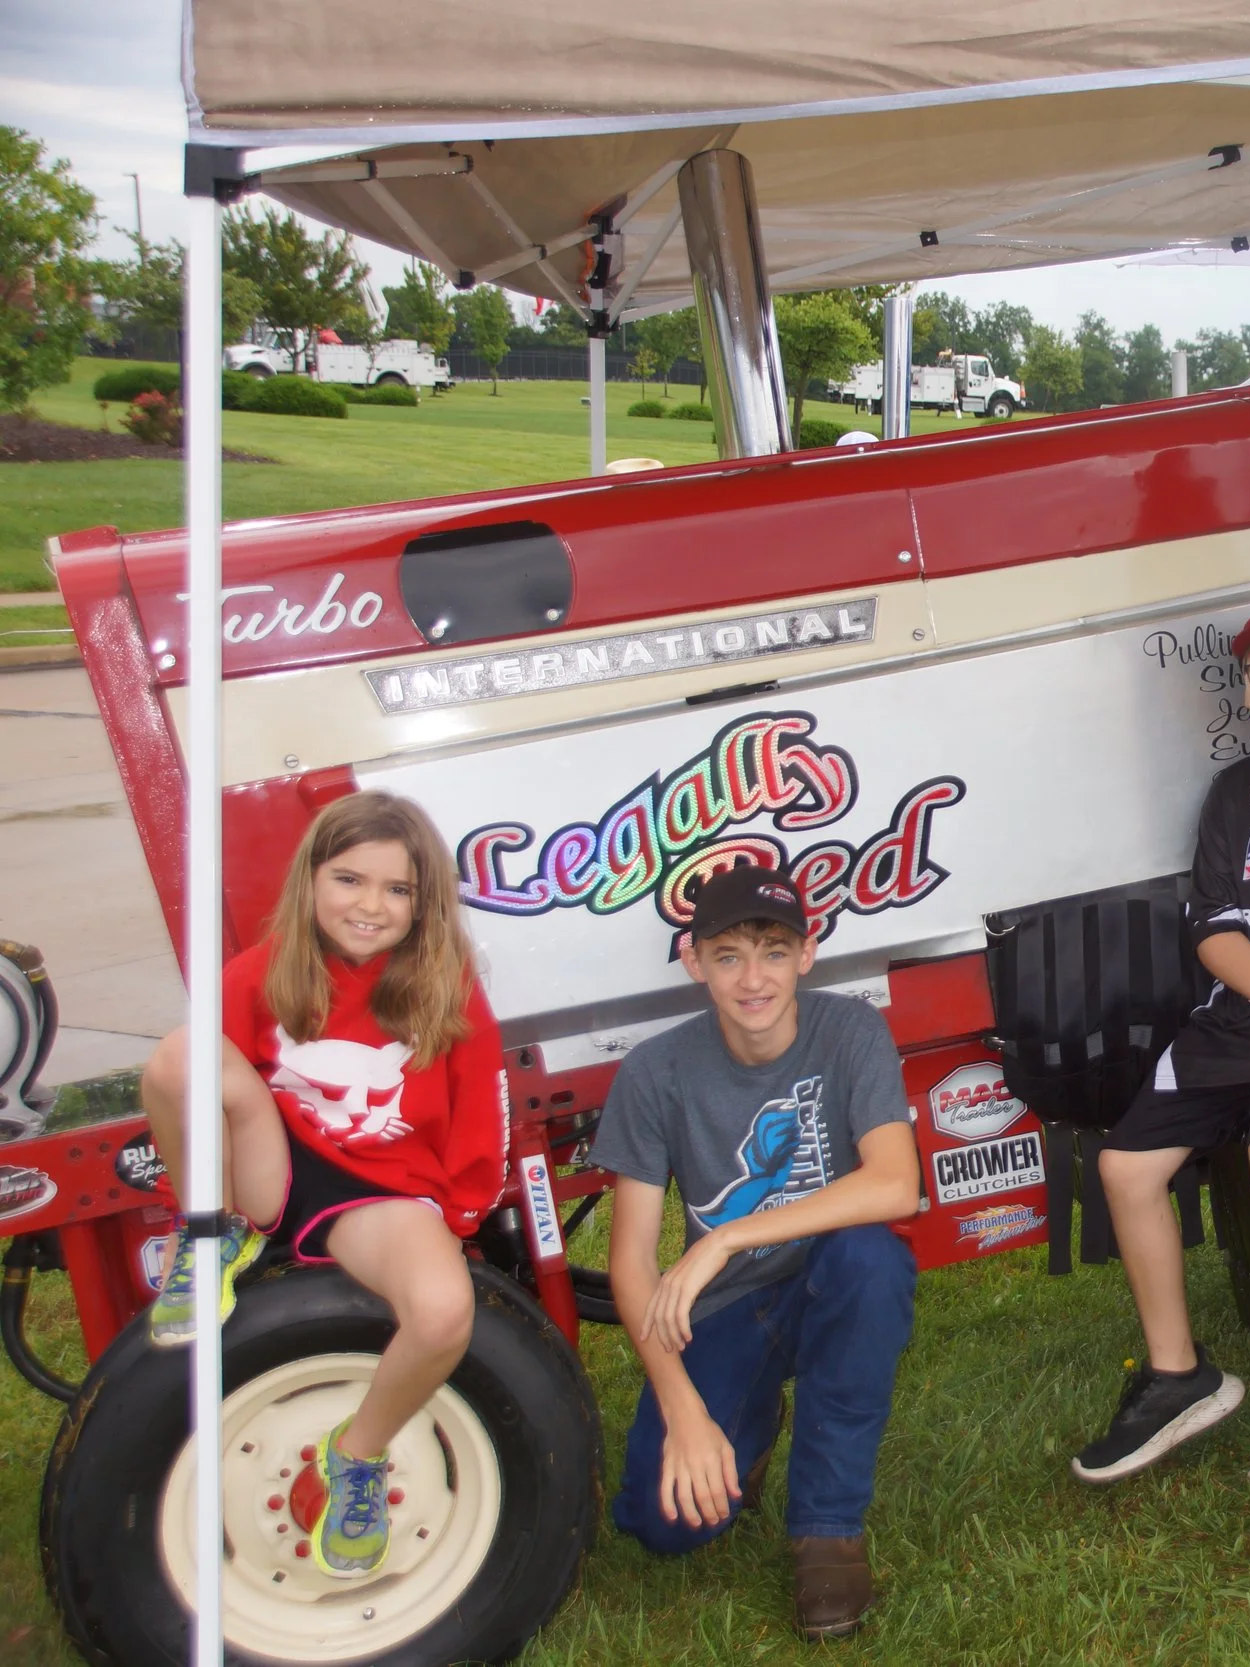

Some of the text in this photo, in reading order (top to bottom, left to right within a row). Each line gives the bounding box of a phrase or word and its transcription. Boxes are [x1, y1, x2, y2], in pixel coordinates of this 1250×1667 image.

[388, 607, 867, 703] INTERNATIONAL
[1143, 623, 1239, 668] Pullin
[456, 709, 860, 916] Legally
[939, 1080, 1012, 1114] MAC
[944, 1096, 1014, 1125] Trailer
[936, 1136, 1041, 1187] CROWER
[943, 1171, 1041, 1200] CLUTCHES
[531, 1182, 556, 1245] TITAN
[960, 1208, 1034, 1235] PERFORMANCE
